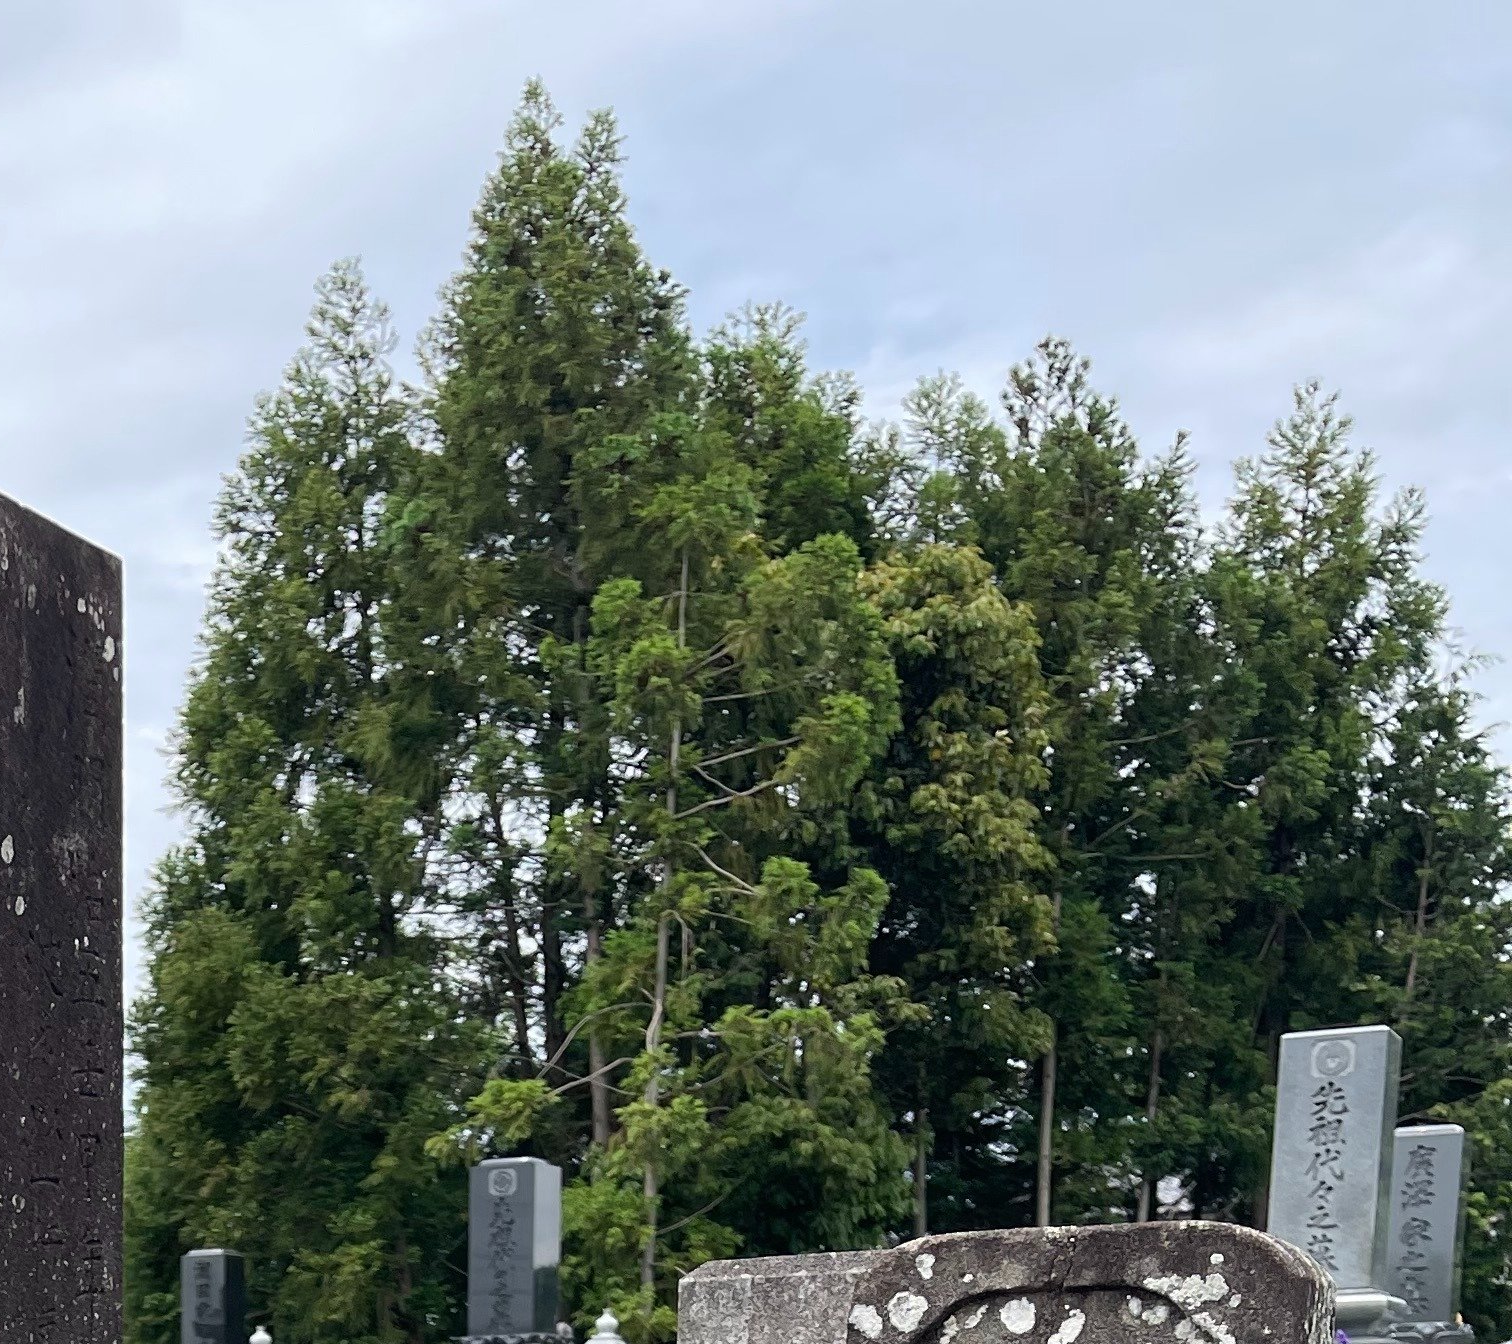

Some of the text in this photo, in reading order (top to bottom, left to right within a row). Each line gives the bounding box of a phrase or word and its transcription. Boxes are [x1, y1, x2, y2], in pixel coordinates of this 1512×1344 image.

[1304, 1081, 1349, 1271] 先祖代々之墓
